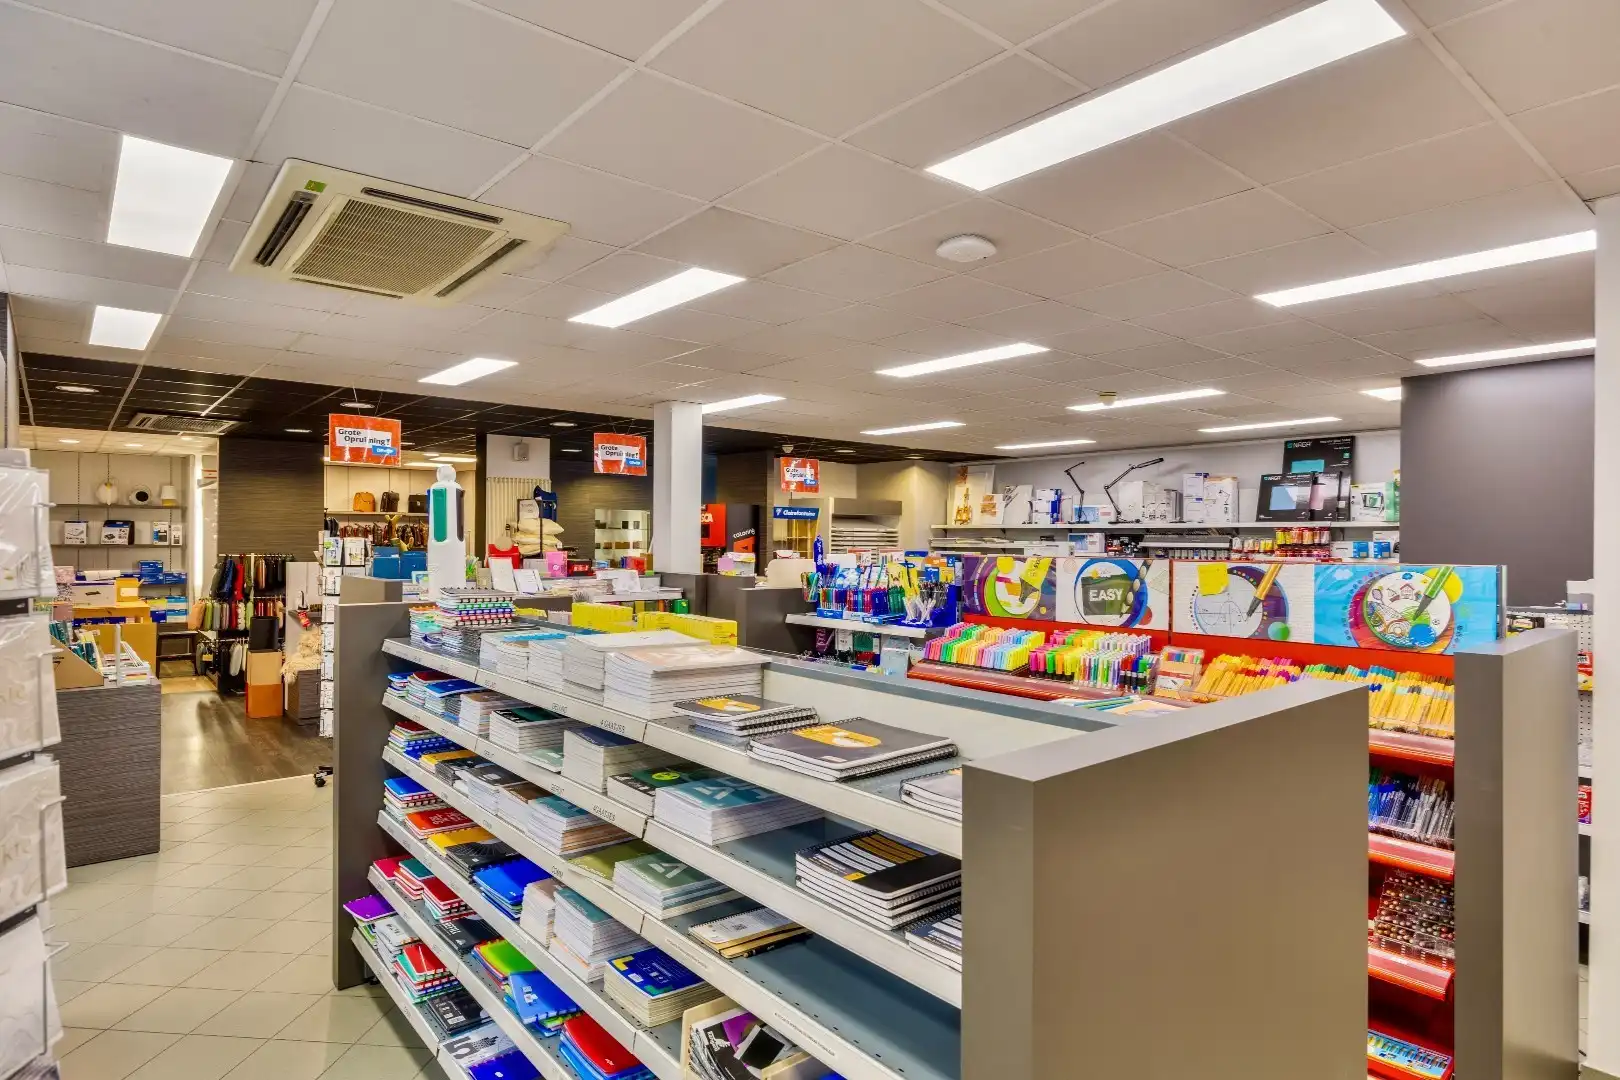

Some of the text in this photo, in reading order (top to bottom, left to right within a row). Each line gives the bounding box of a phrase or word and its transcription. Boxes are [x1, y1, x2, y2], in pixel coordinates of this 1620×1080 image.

[338, 428, 361, 436] Grote
[783, 509, 816, 517] Clairefontaine
[1089, 588, 1123, 602] EASY
